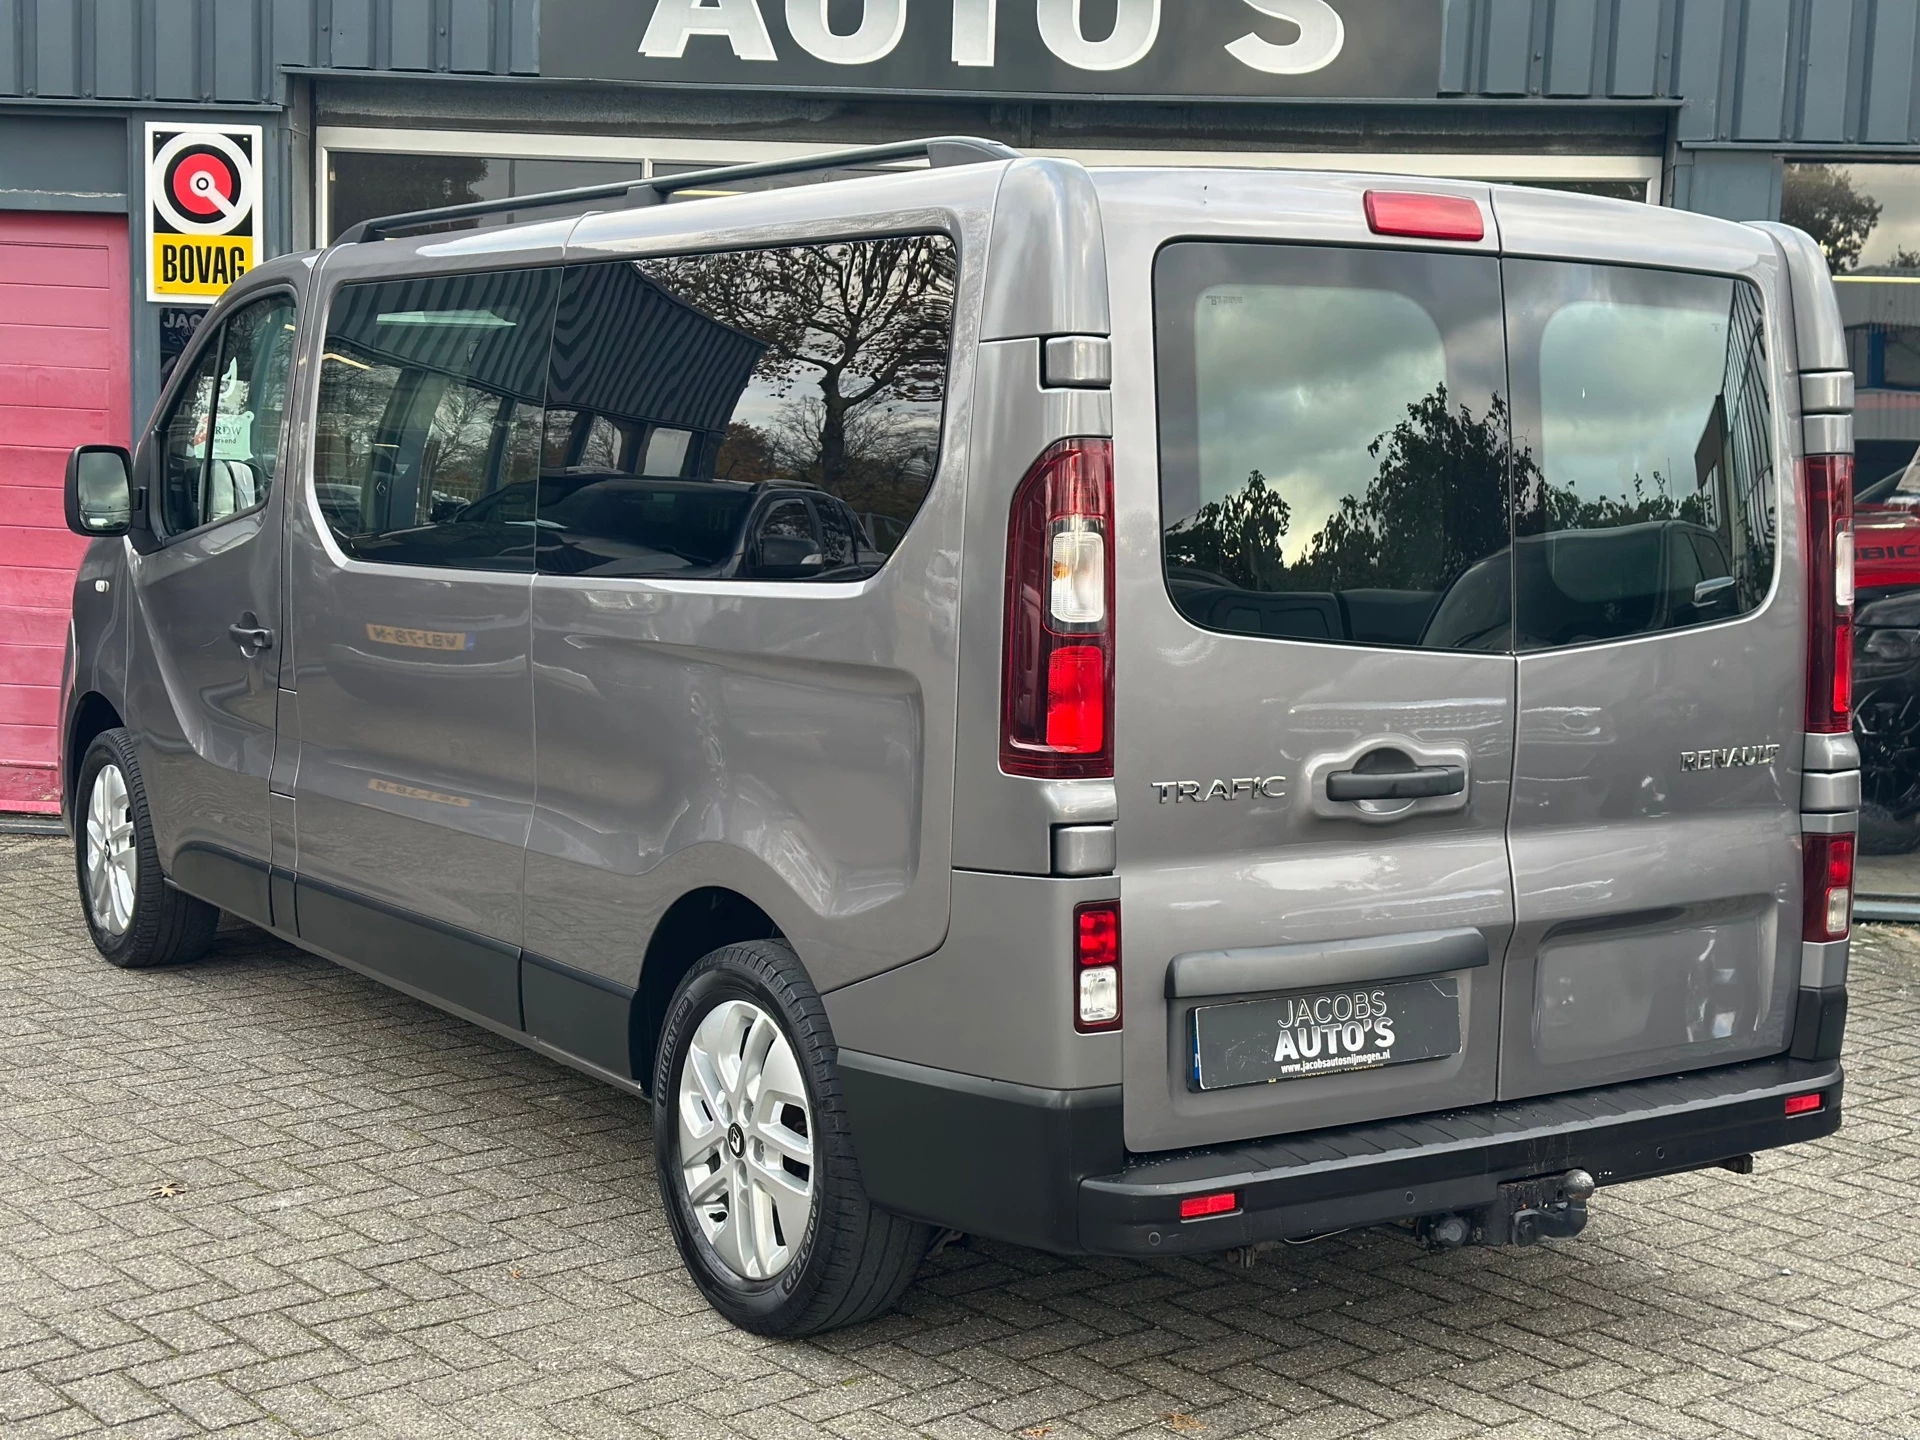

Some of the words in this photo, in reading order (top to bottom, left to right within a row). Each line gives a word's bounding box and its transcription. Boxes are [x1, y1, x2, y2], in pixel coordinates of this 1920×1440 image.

[162, 244, 245, 285] BOVAG
[163, 313, 204, 329] JAC
[215, 425, 242, 435] RDW
[1680, 744, 1780, 772] RENAULT
[1151, 775, 1287, 804] TRAFIC
[1277, 989, 1387, 1028] JACOBS
[657, 1025, 679, 1098] EFFICIENT
[675, 999, 689, 1024] GRIP
[1274, 1016, 1396, 1062] AUTO'S
[1281, 1049, 1391, 1074] www.jacobsautosnijmegen.nl
